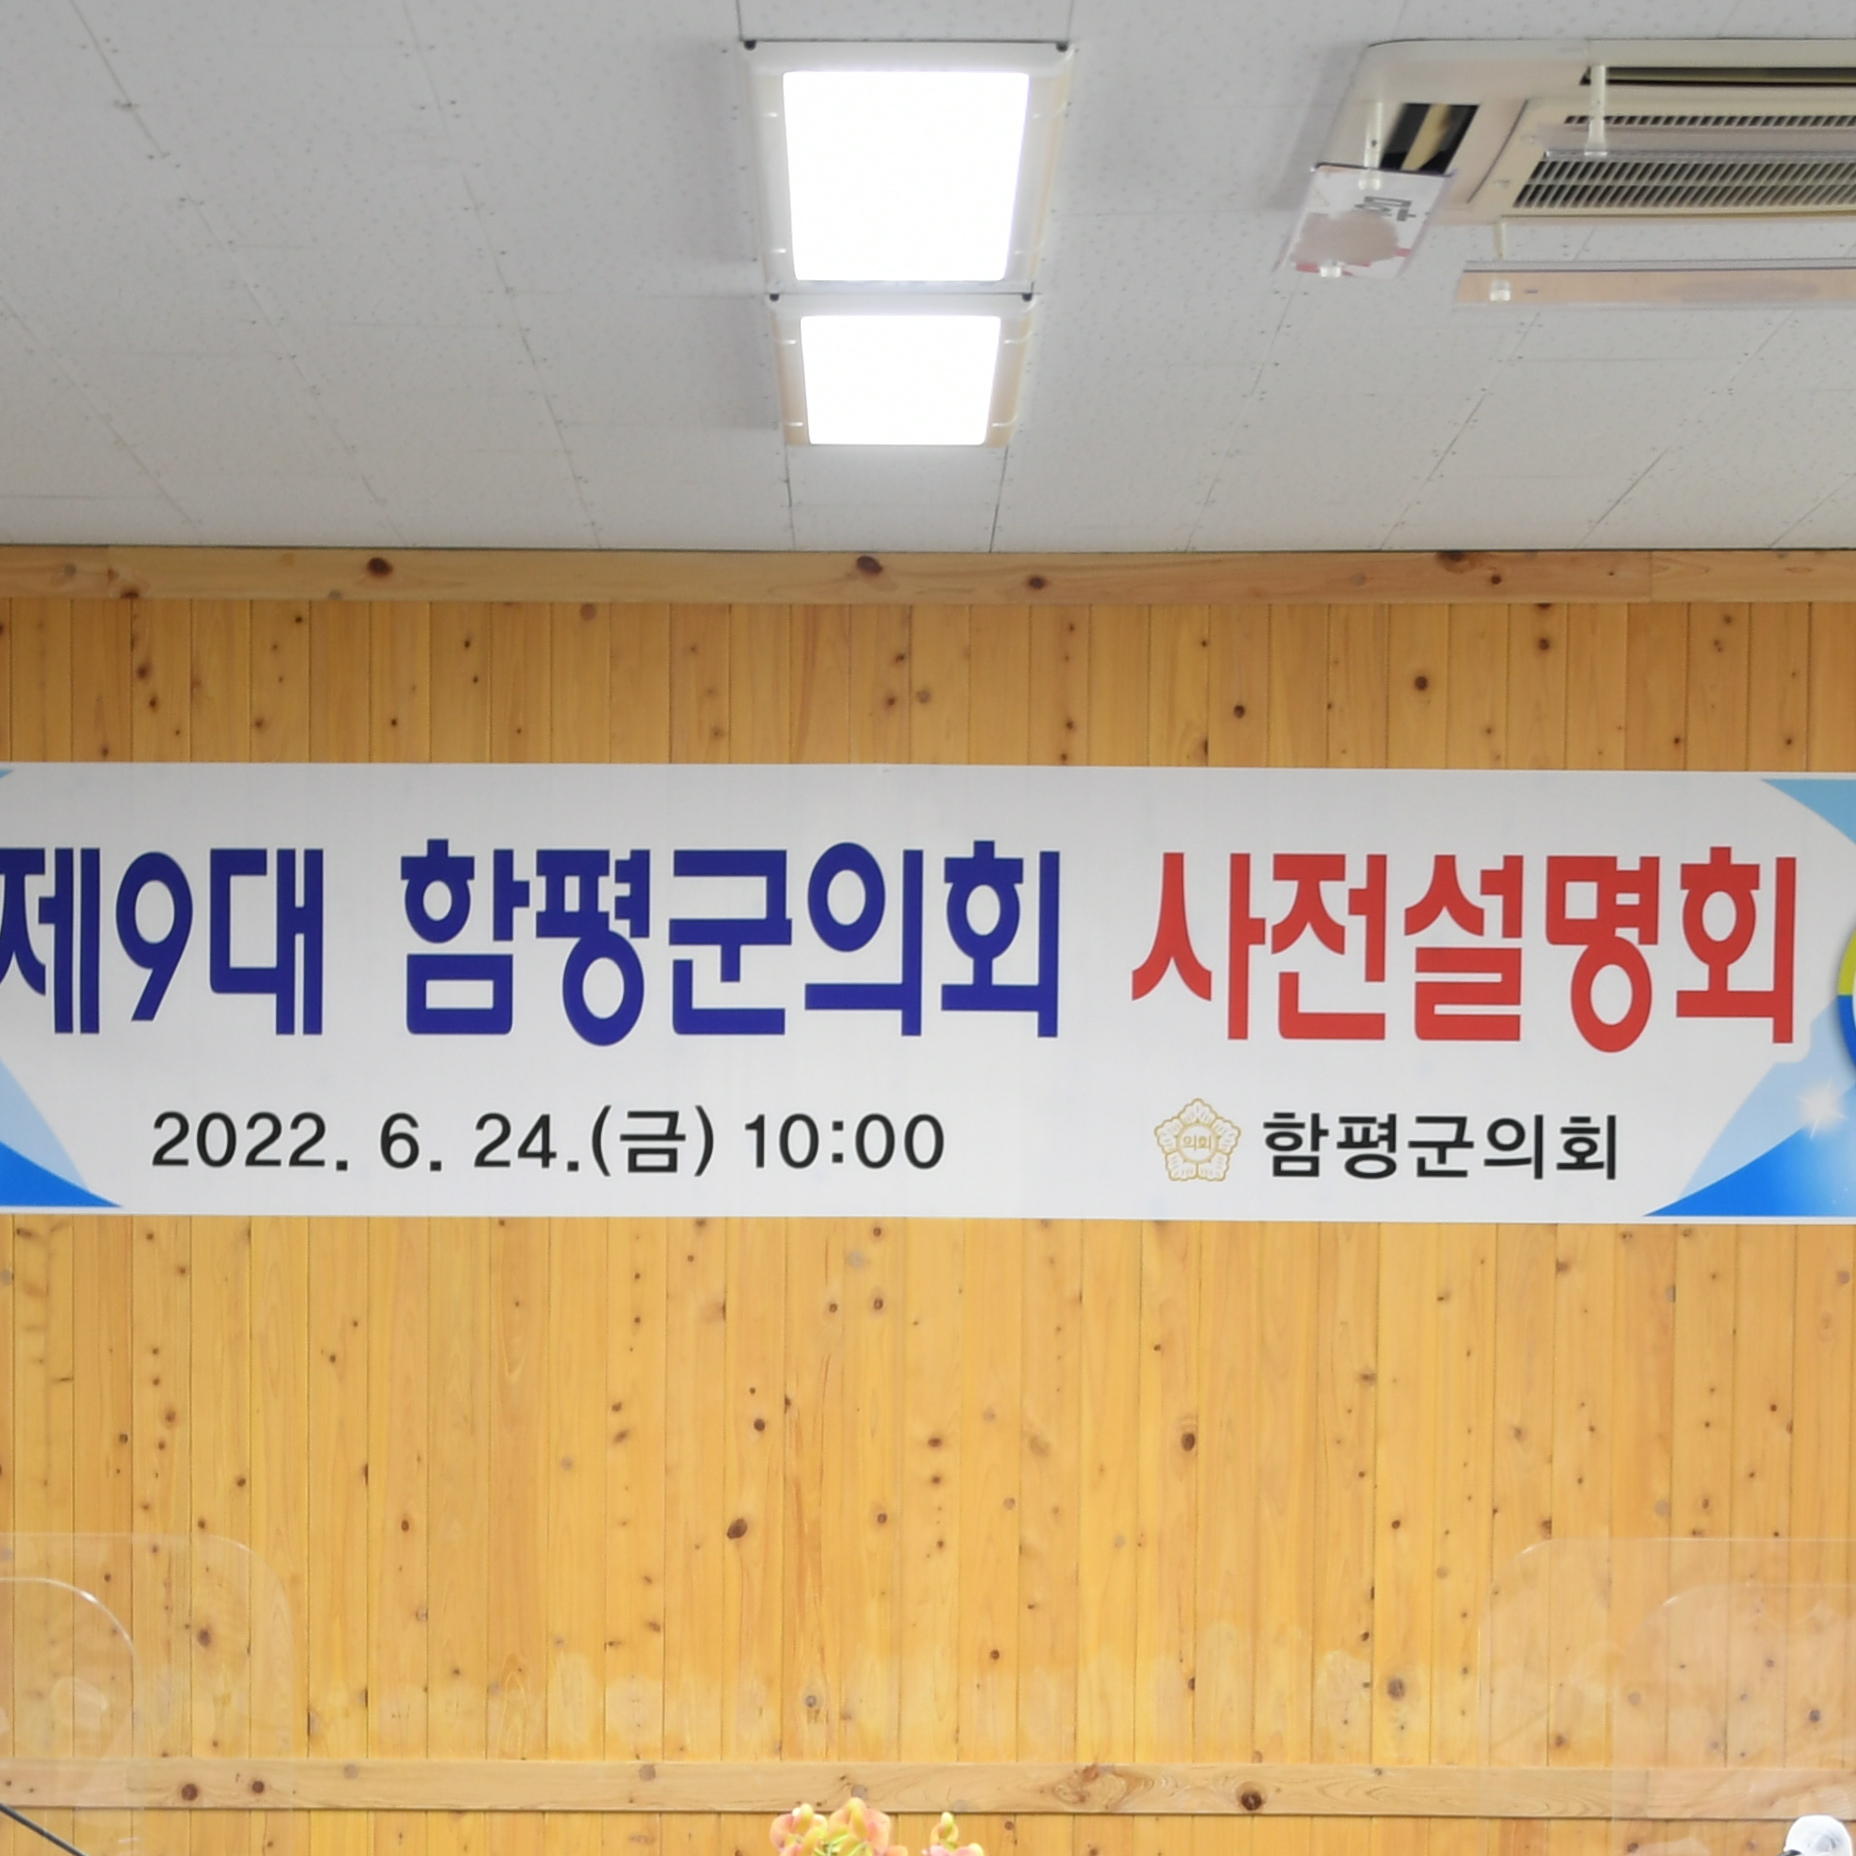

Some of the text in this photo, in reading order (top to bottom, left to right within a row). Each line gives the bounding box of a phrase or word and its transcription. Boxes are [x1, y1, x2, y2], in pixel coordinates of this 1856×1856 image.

[401, 839, 1060, 1046] 함평군의회
[1131, 846, 1798, 1053] 사전설명회
[152, 1111, 348, 1171] 2022.
[380, 1112, 442, 1172] 6.
[745, 1113, 944, 1169] 10:00
[1263, 1112, 1616, 1180] 함평군의회
